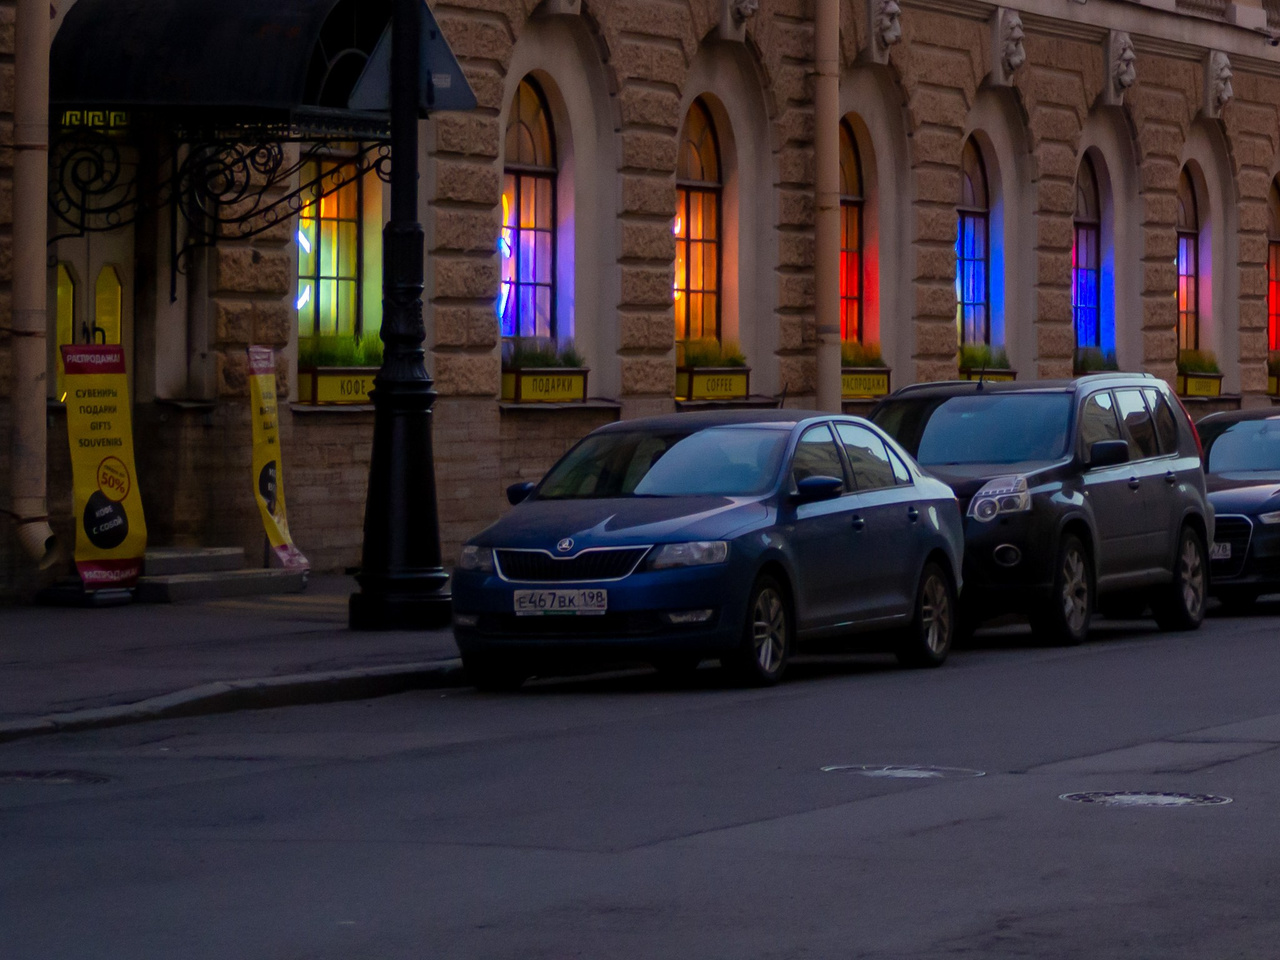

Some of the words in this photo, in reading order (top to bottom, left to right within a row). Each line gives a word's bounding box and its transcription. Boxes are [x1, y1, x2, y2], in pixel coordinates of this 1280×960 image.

[66, 353, 120, 365] РАСПРОДАЖА!
[340, 379, 366, 395] КОФЕ
[532, 378, 573, 395] ПОДАРКИ
[706, 378, 733, 392] COFFEE
[75, 388, 118, 398] СУВЕНИРЫ
[79, 405, 117, 416] ПОДАРКИ
[90, 422, 112, 431] GIFTS
[79, 438, 122, 448] SOUVENIRS
[101, 472, 125, 494] 50%
[95, 505, 113, 518] КОФЕ
